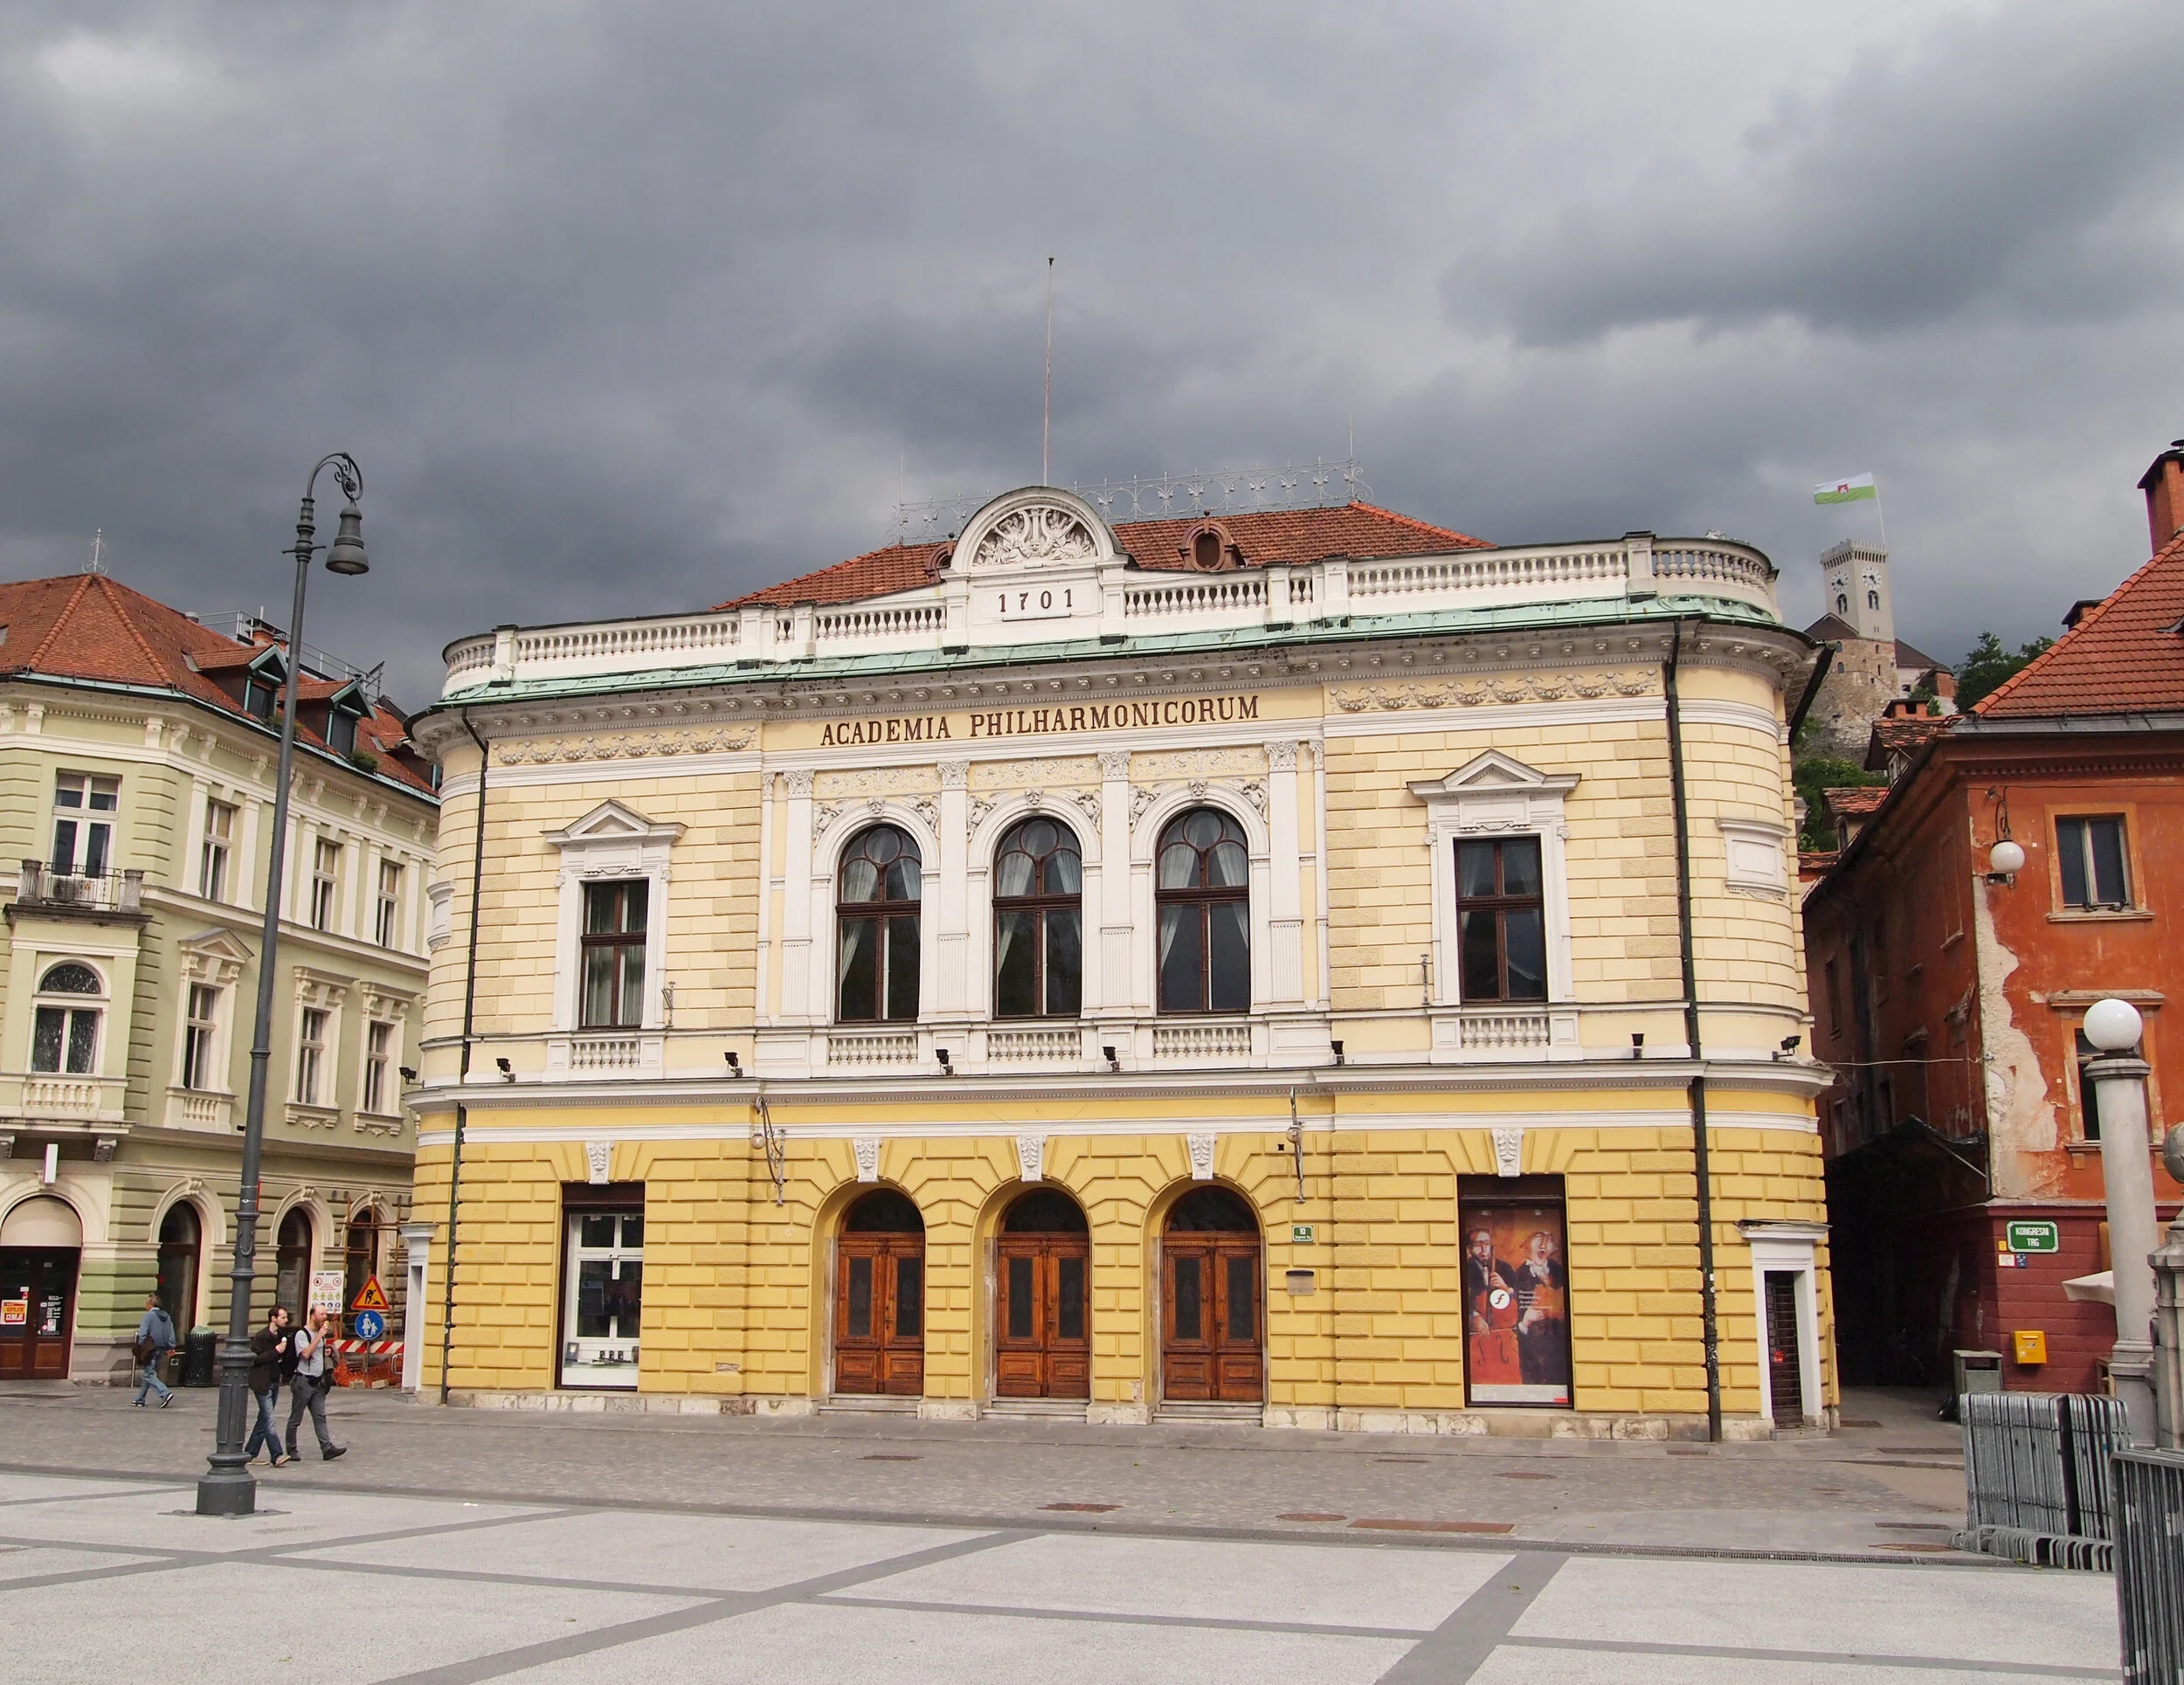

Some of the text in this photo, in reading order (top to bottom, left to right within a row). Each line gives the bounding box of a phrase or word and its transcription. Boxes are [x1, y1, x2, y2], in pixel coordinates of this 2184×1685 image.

[999, 589, 1072, 612] 1701
[820, 695, 1259, 746] ACADEMIA PHILHARMONICORUM
[2015, 1226, 2049, 1236] KONGRESNI
[2027, 1238, 2040, 1246] TRG
